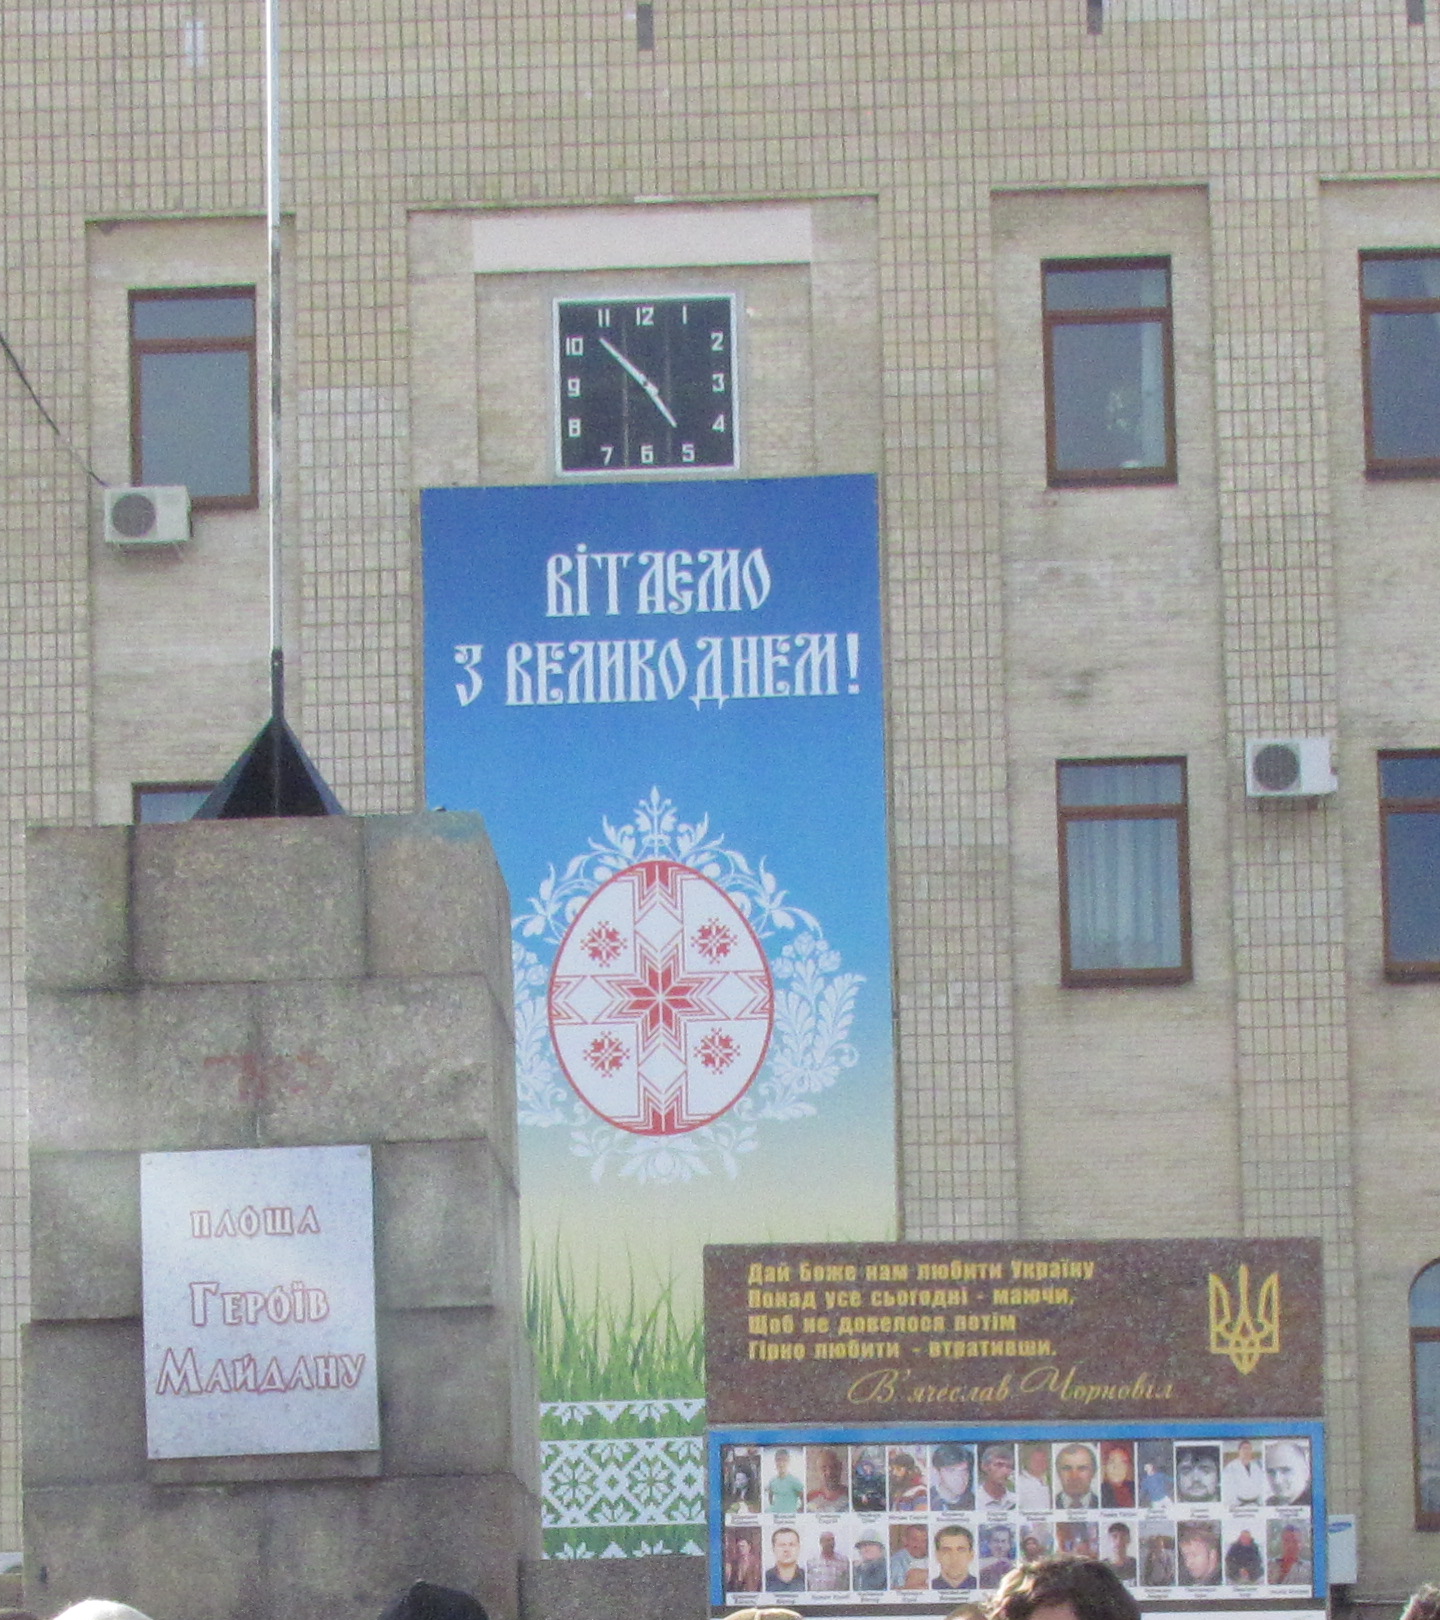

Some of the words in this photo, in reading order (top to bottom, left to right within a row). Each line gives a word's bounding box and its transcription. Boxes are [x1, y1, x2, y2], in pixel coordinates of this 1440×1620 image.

[598, 308, 611, 327] 11
[635, 306, 655, 327] 12
[565, 336, 584, 356] 10
[710, 331, 725, 351] 2
[567, 377, 581, 397] 9
[711, 373, 726, 393] 3
[568, 417, 582, 437] 8
[711, 413, 726, 433] 4
[600, 446, 613, 466] 7
[640, 444, 654, 464] 6
[681, 443, 696, 463] 5
[747, 1261, 791, 1286] Дай
[799, 1260, 858, 1283] Боже
[865, 1262, 910, 1282] нам
[916, 1258, 1004, 1282] любити
[1010, 1258, 1096, 1282] Україну
[747, 1287, 817, 1311] Понад
[824, 1289, 864, 1311] усе
[870, 1286, 969, 1310] сьогодні
[747, 1313, 796, 1338] Щоб
[802, 1316, 830, 1334] не
[953, 1312, 1017, 1333] потім
[813, 1337, 901, 1360] любити
[928, 1337, 1058, 1360] втративши.
